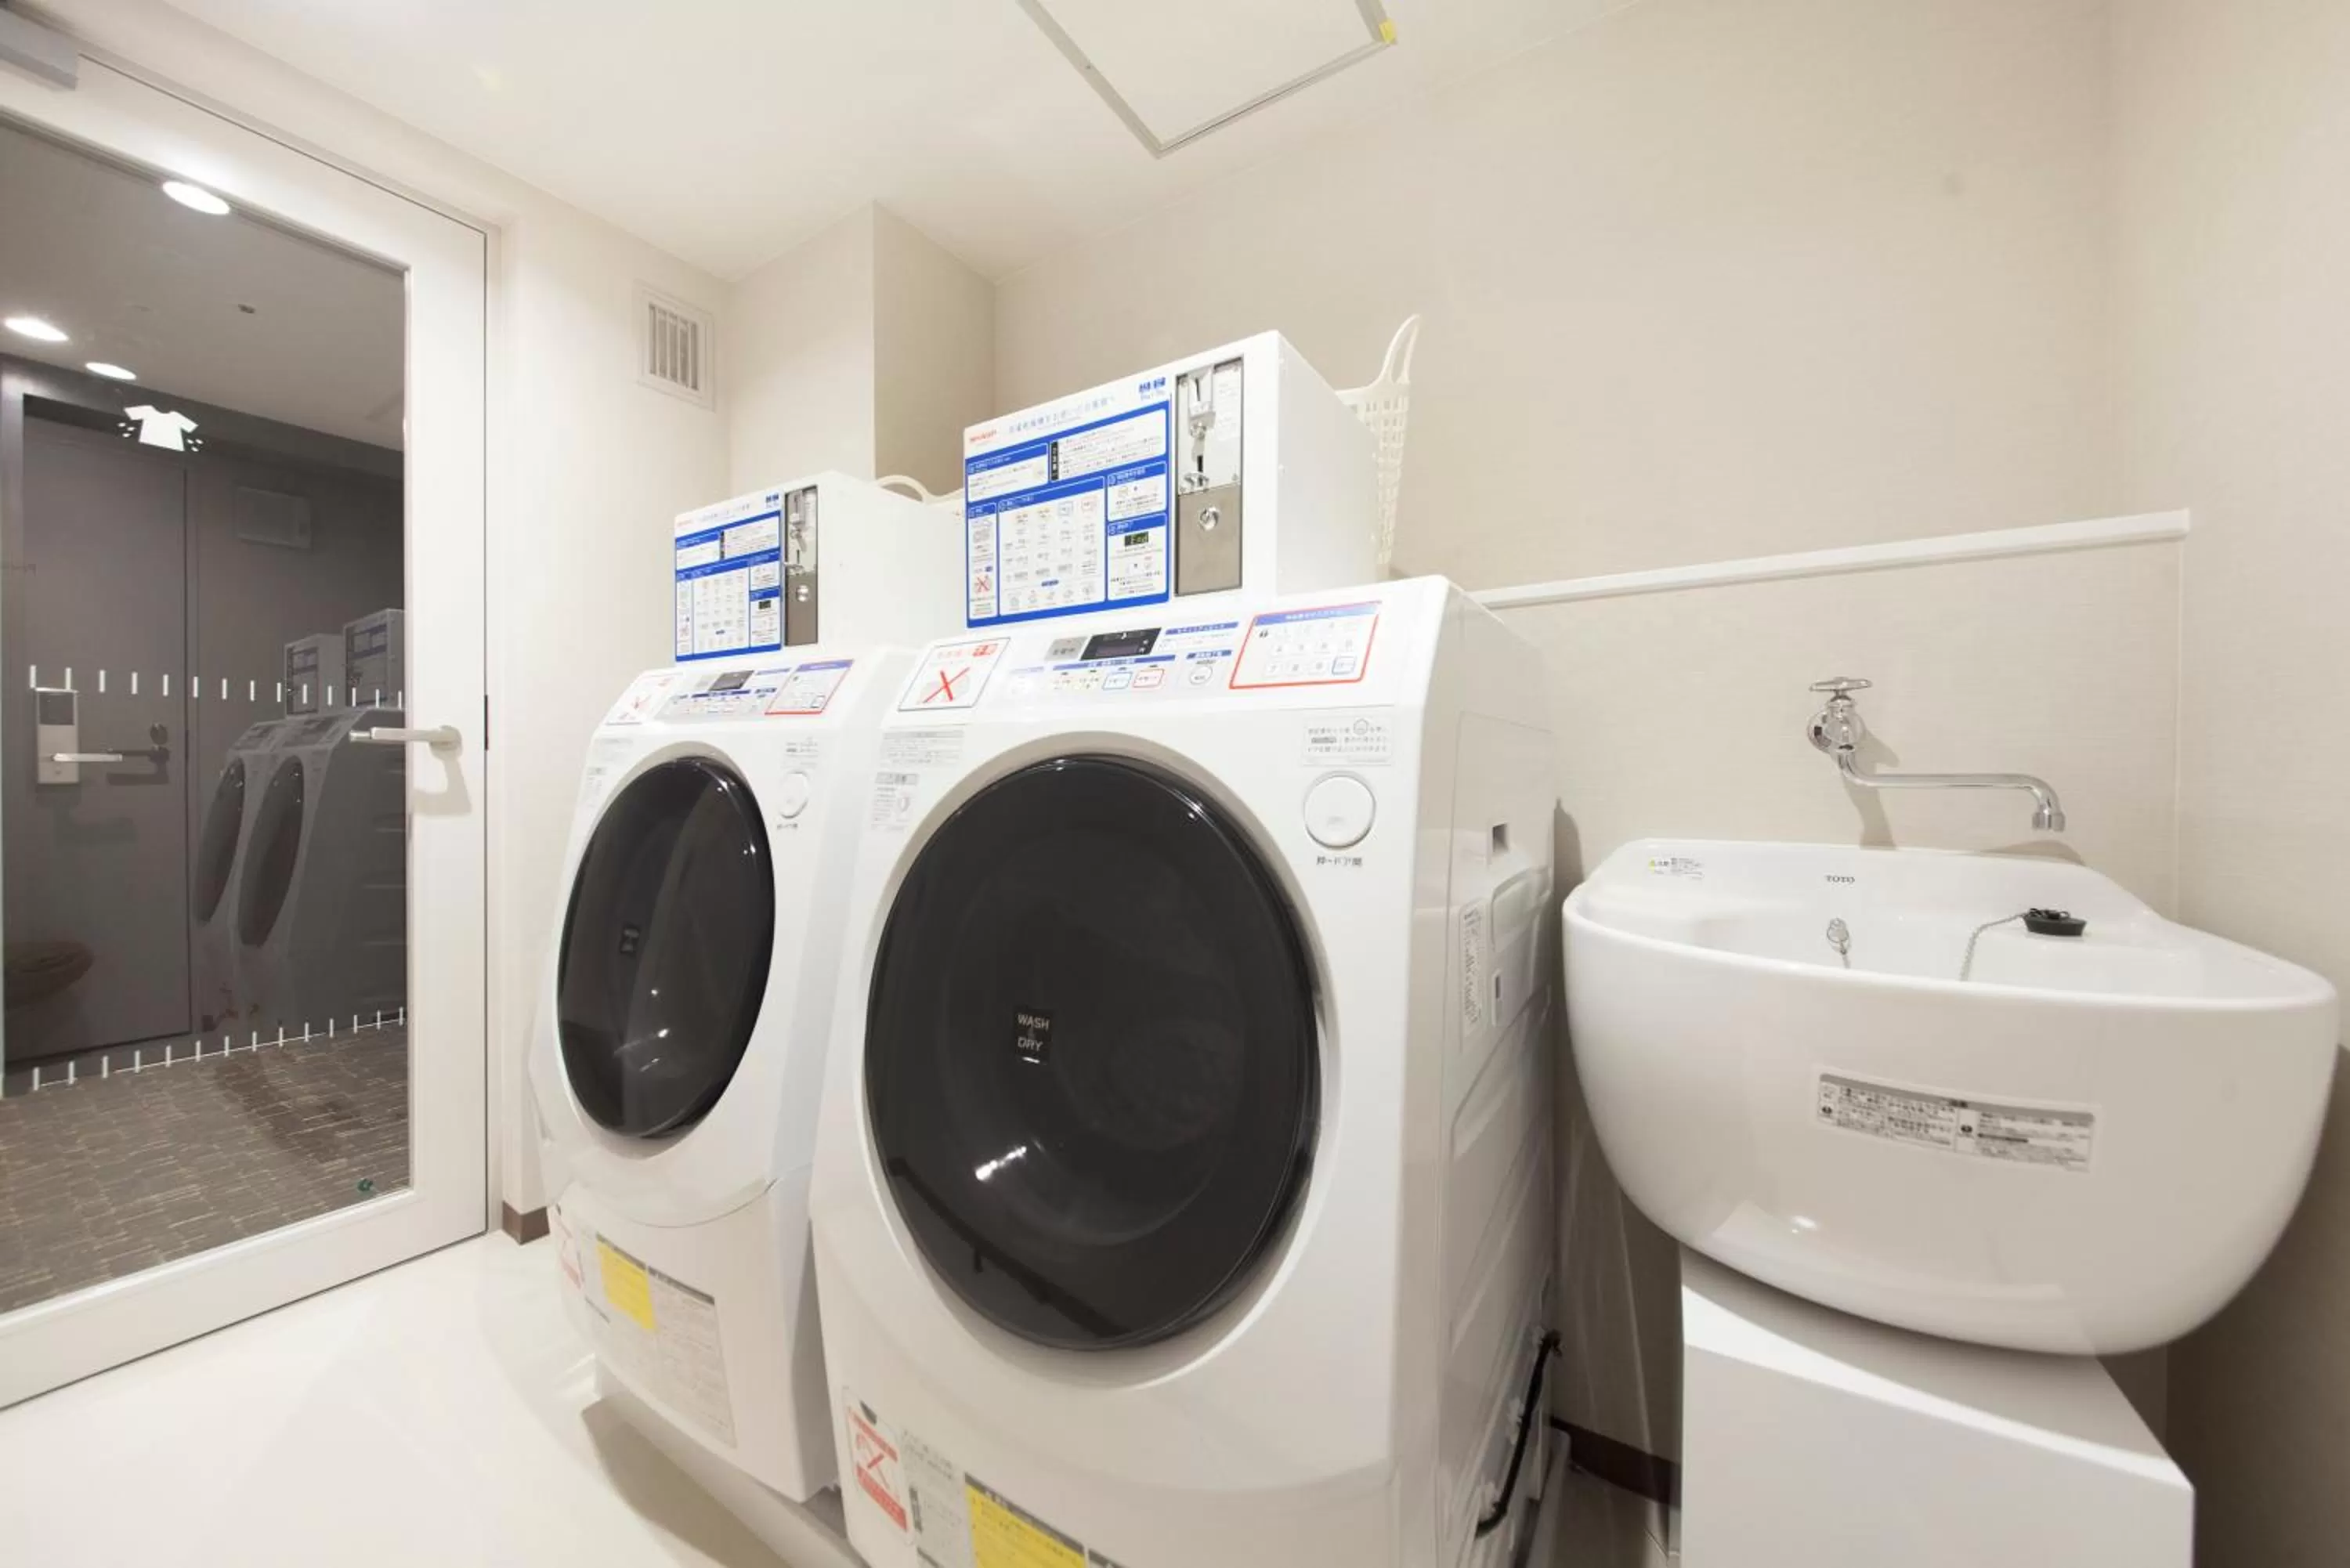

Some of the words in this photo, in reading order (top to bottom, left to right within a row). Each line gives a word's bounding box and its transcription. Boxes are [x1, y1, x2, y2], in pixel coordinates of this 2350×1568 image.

[1825, 874, 1856, 883] TOTO
[1017, 1013, 1050, 1031] WASH
[1017, 1035, 1043, 1052] DRY
